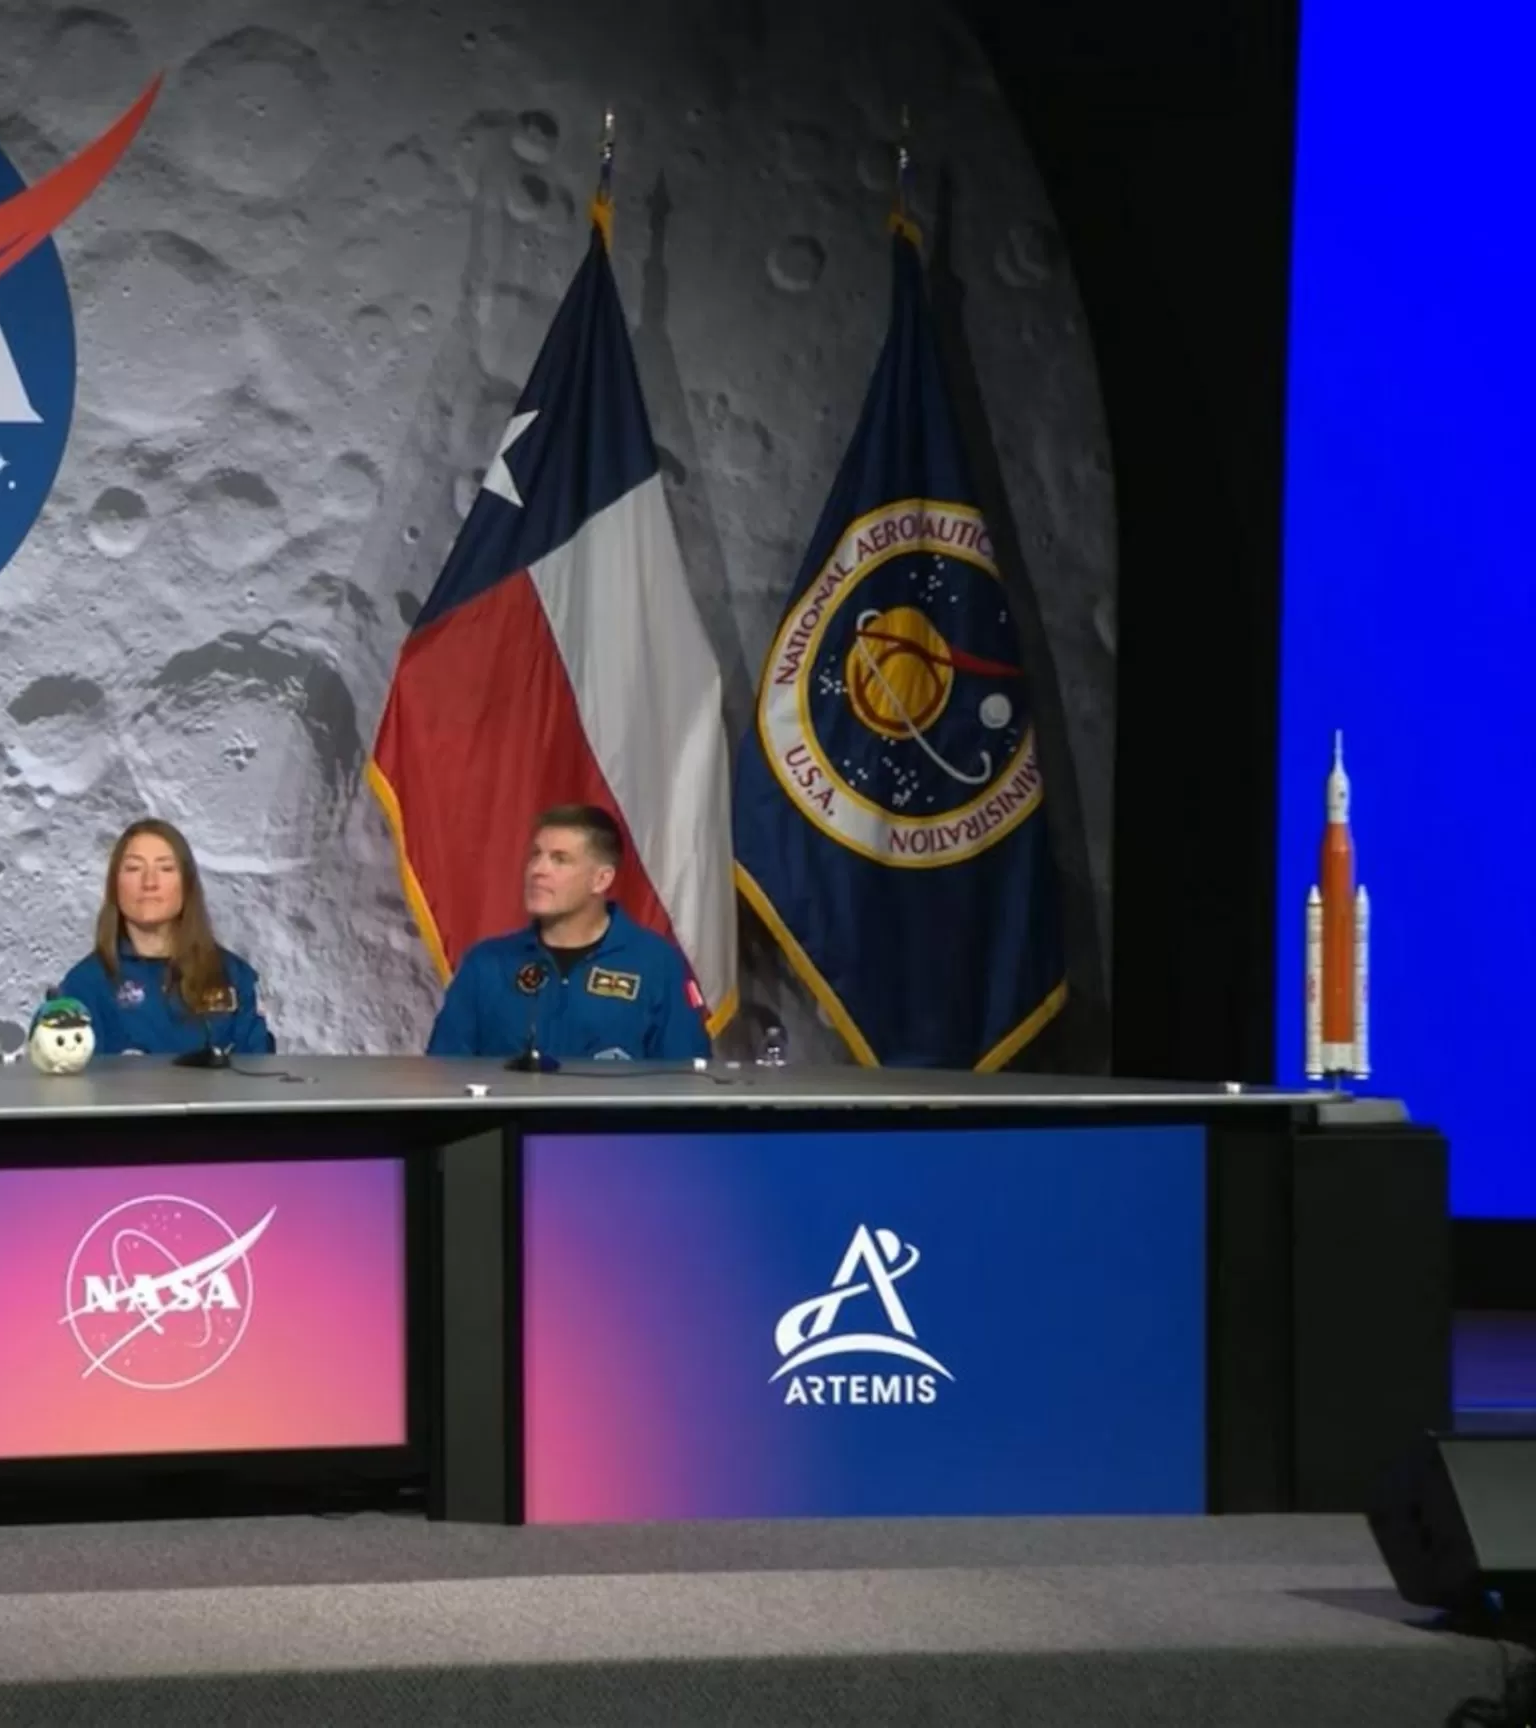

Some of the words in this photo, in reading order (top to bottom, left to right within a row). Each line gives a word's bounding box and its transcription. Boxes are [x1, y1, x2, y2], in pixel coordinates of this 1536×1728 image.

[774, 562, 854, 685] NATIONAL
[785, 744, 835, 816] U.S.A.
[83, 1270, 241, 1313] NASA
[784, 1375, 937, 1405] ARTEMIS
